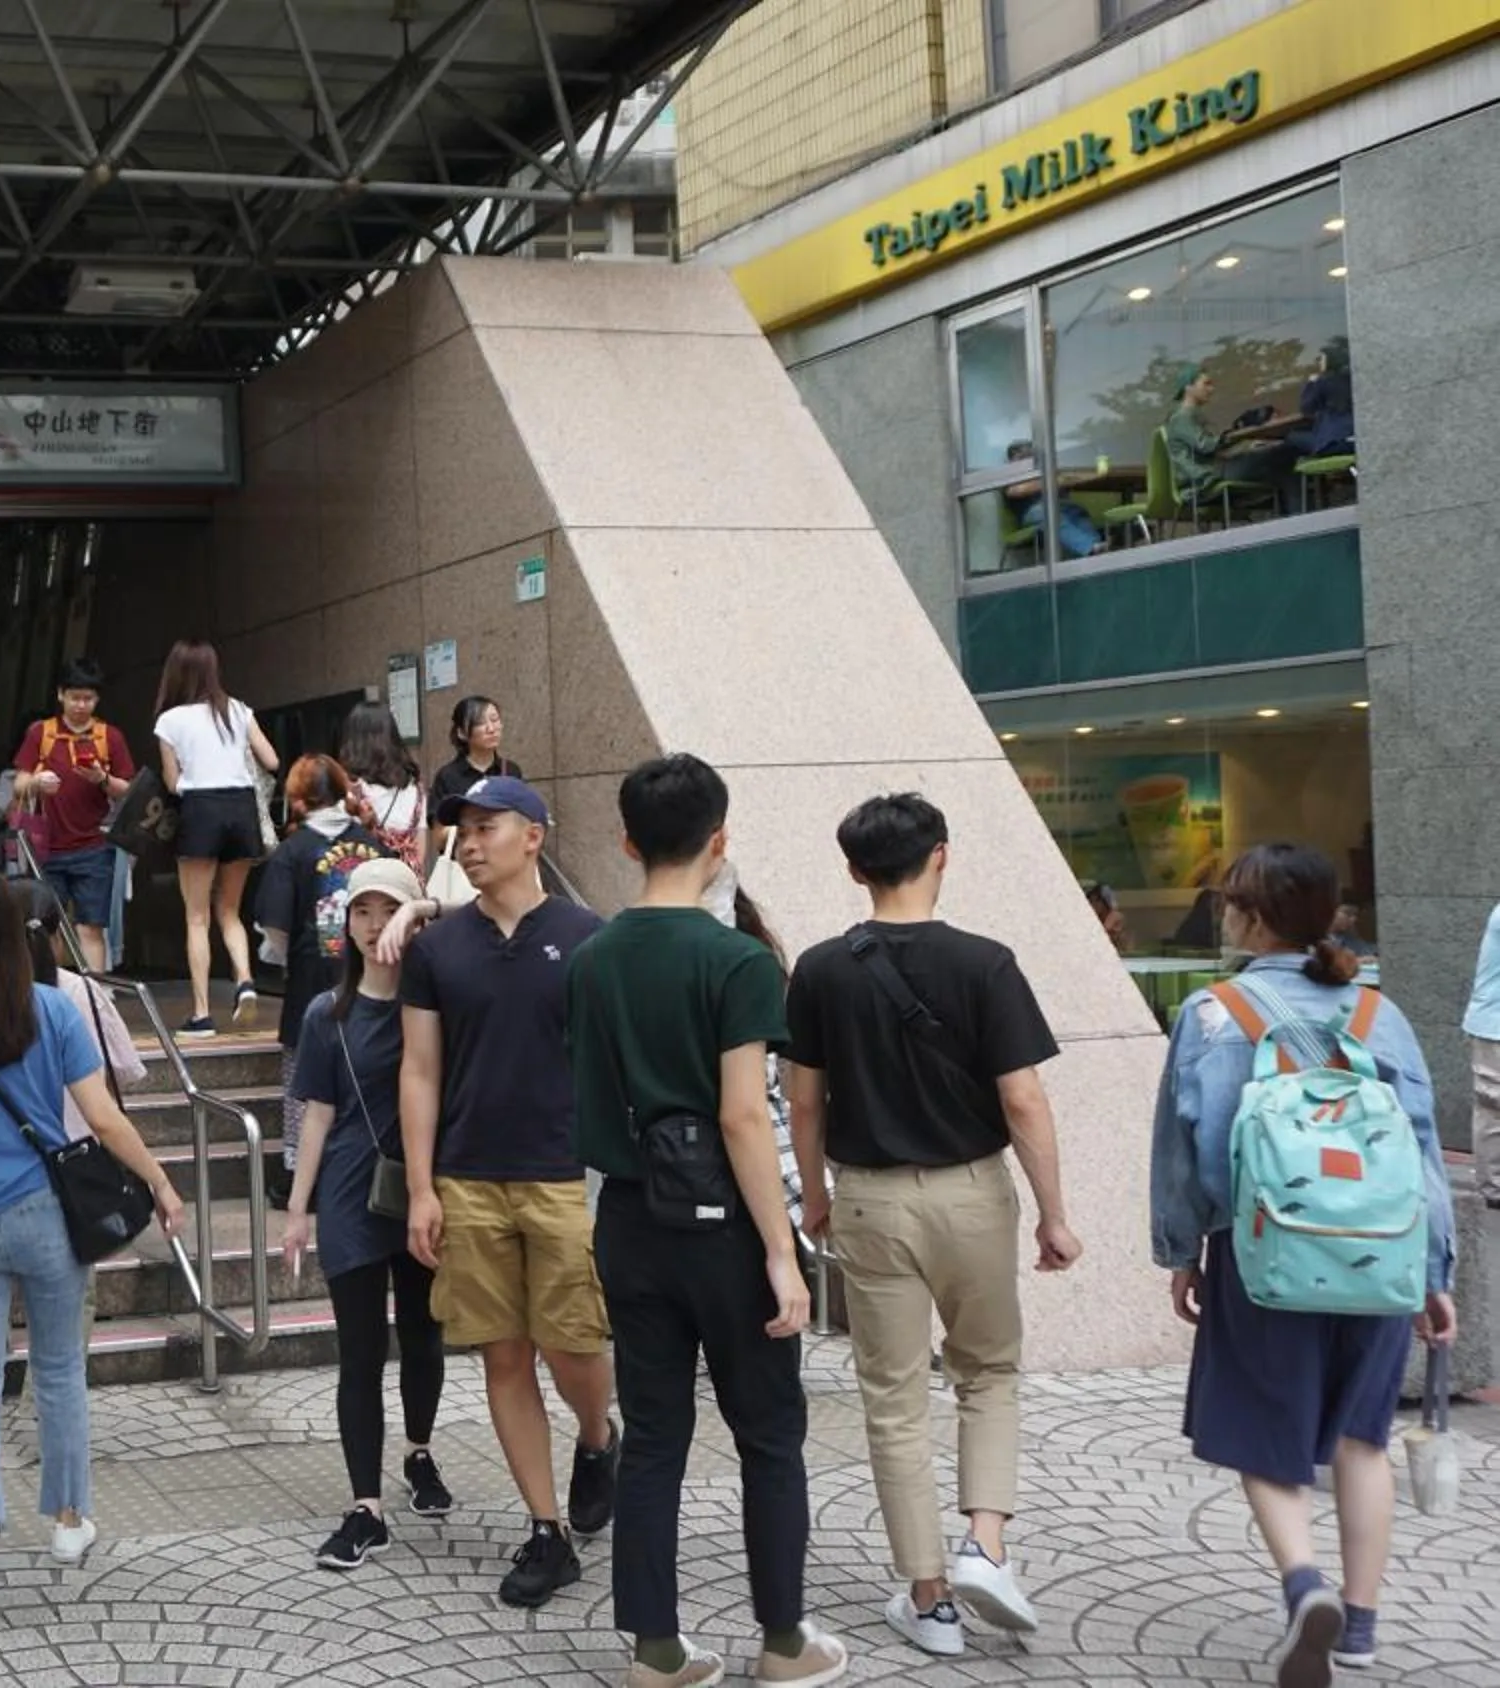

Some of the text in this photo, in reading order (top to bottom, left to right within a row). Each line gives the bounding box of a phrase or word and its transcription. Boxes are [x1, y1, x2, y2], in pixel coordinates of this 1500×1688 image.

[864, 69, 1261, 267] Taipei Milk King
[23, 408, 159, 438] 中山地下街
